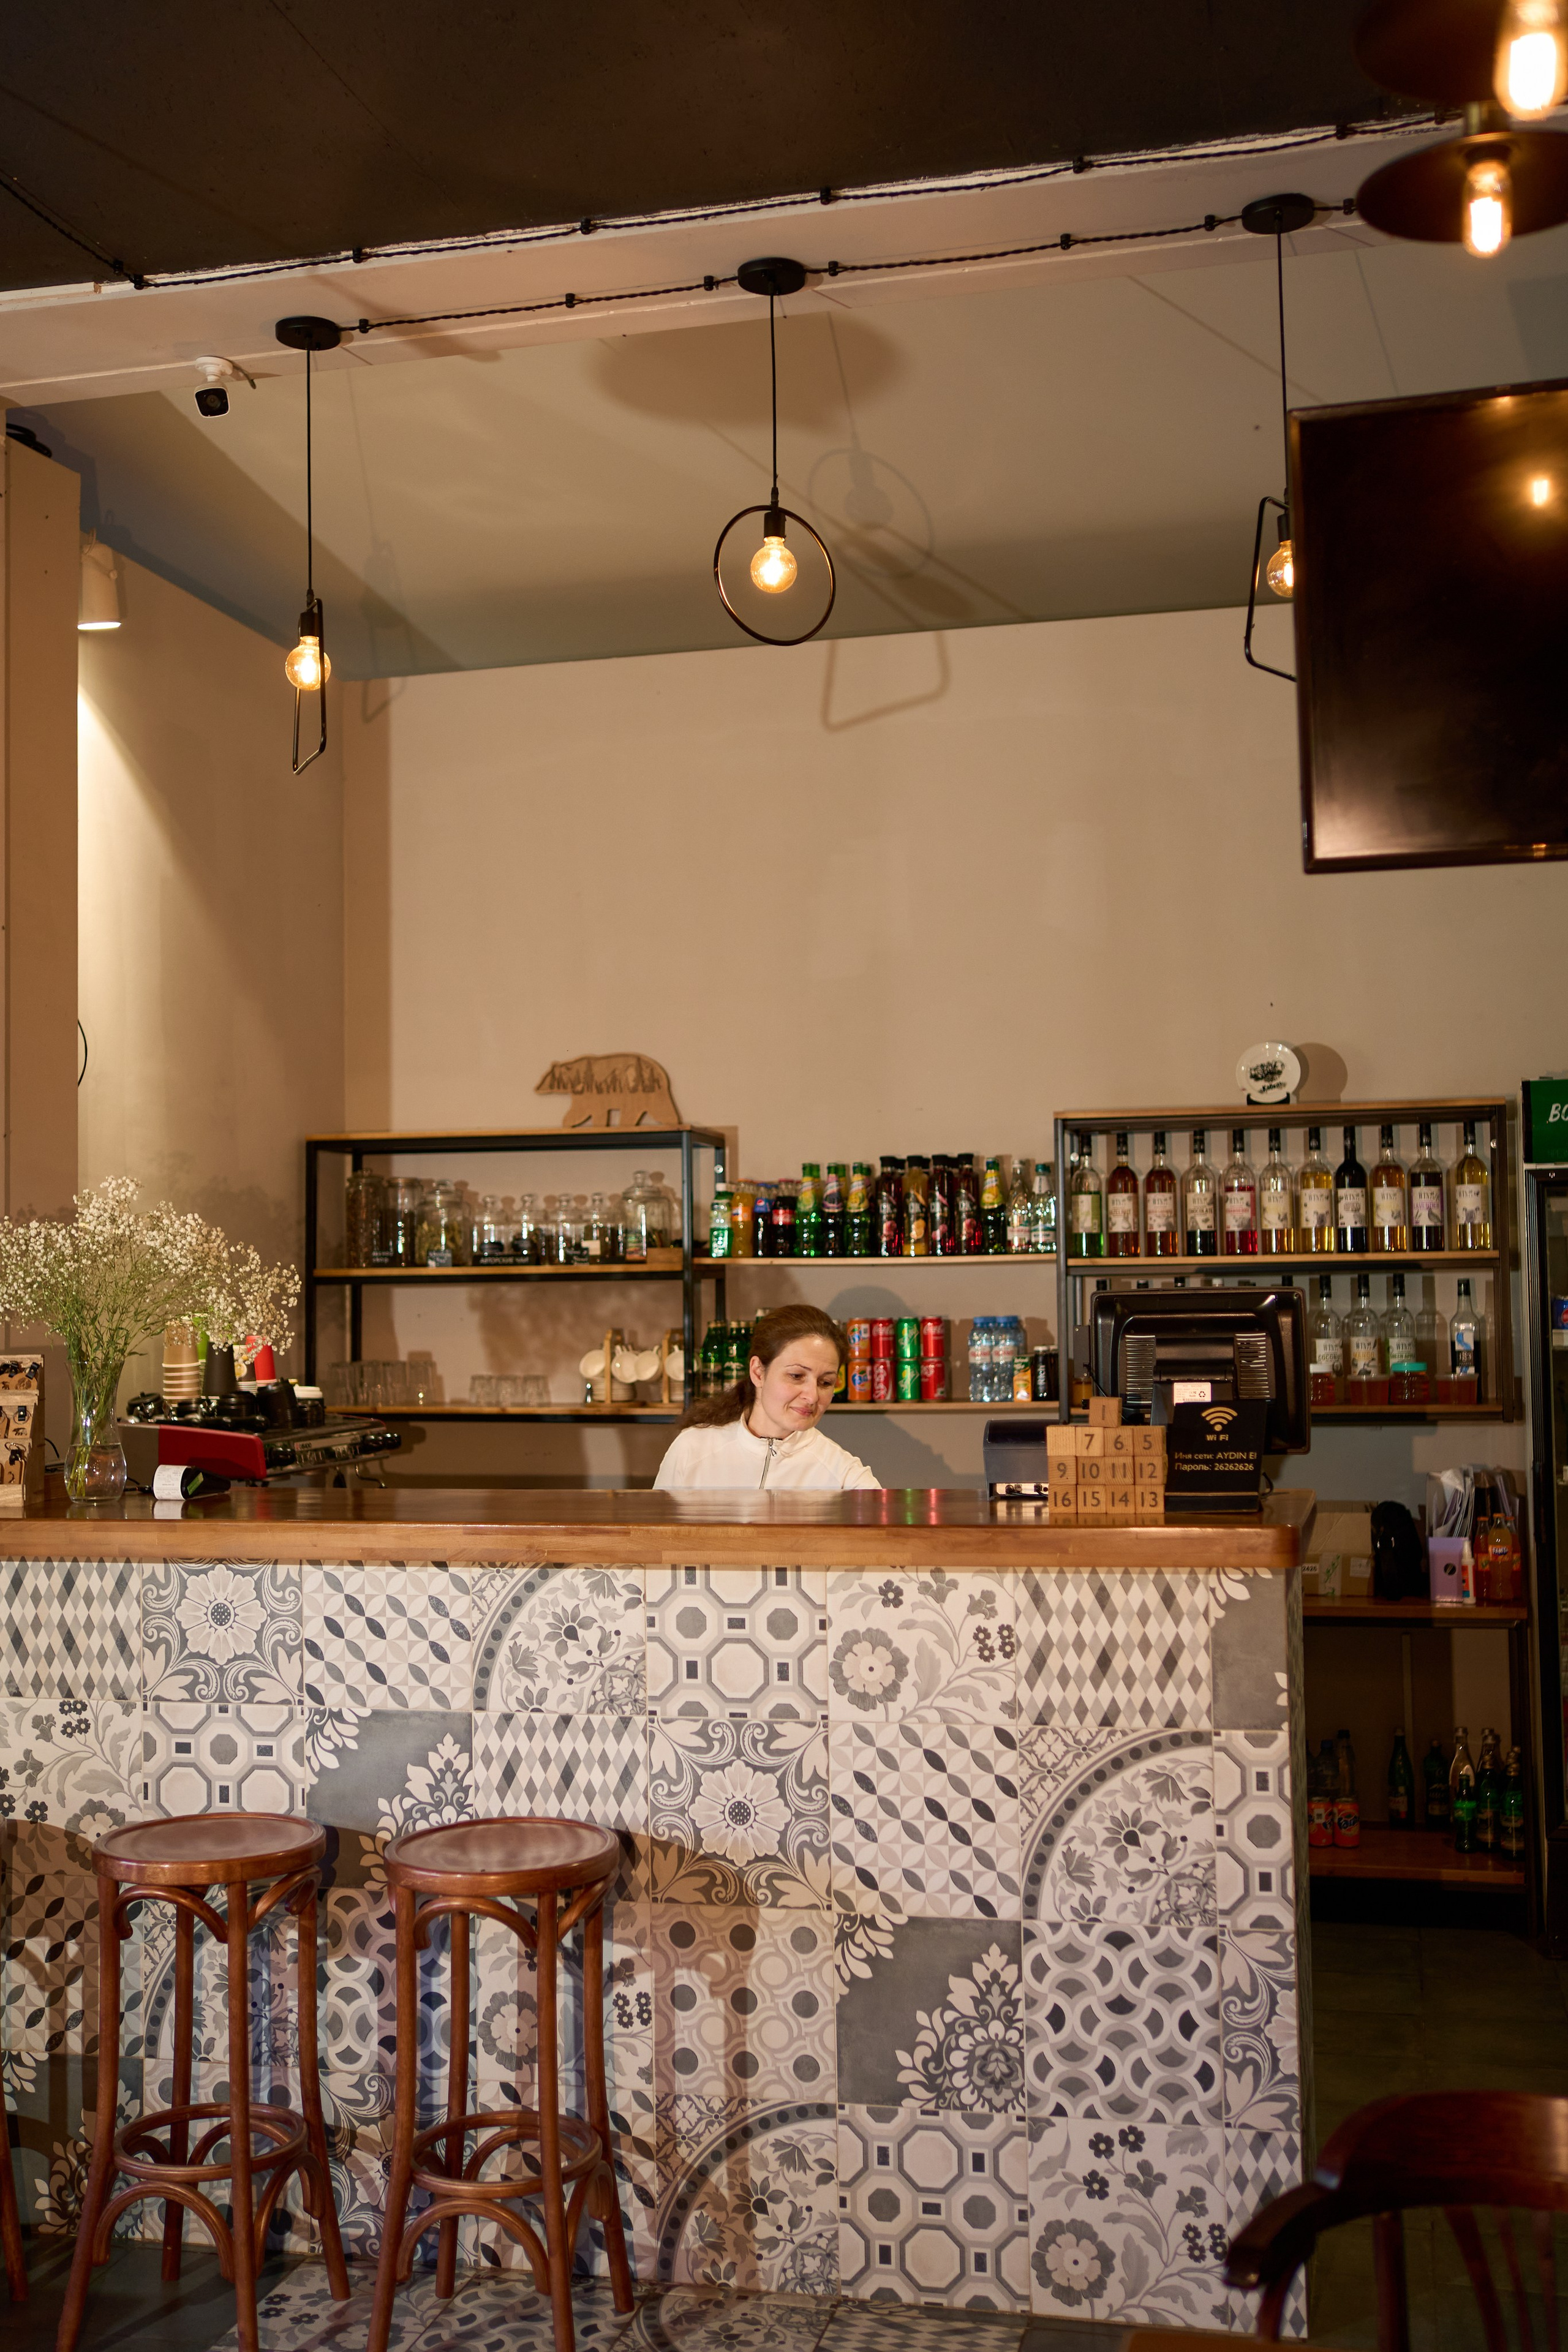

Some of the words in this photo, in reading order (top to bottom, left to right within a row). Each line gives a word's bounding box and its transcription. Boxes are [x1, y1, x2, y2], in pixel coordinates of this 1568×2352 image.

[1084, 1434, 1095, 1450] 7
[1142, 1434, 1152, 1450] 5
[1082, 1463, 1099, 1479] 10
[1112, 1463, 1126, 1479] 11
[1140, 1463, 1157, 1479] 12
[1175, 1463, 1212, 1471] Пароль:
[1054, 1491, 1071, 1507] 16
[1084, 1491, 1101, 1507] 15
[1112, 1491, 1129, 1507] 14
[1141, 1491, 1158, 1507] 13
